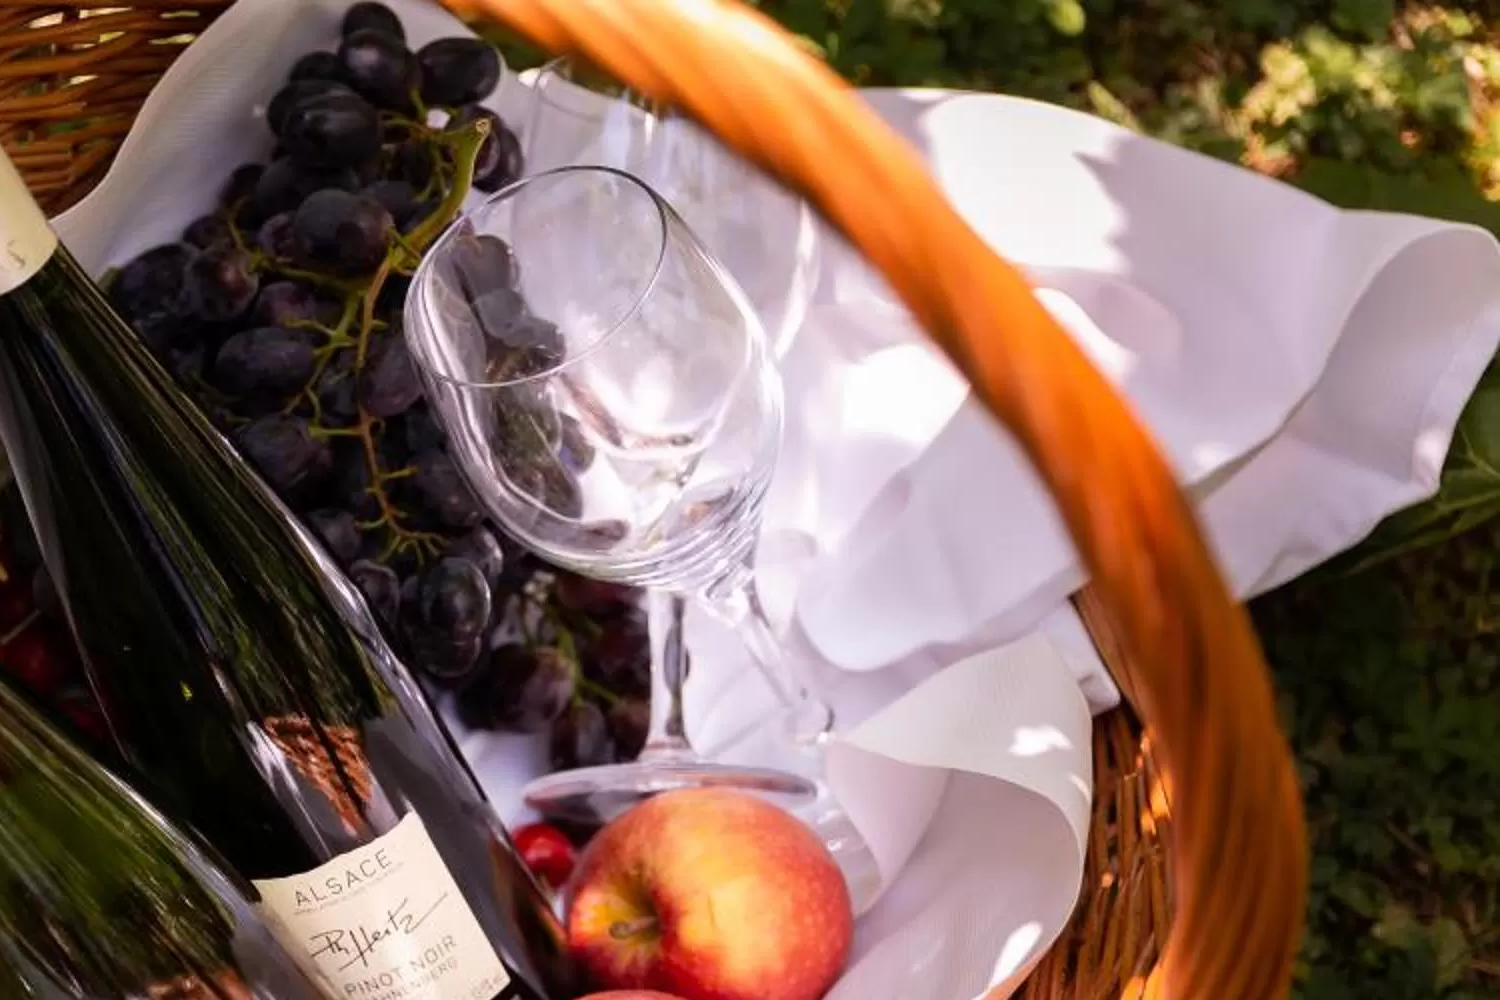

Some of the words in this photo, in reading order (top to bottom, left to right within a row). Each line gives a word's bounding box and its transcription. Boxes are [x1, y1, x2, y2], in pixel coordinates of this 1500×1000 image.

[294, 848, 392, 906] ALSACE
[344, 966, 402, 996] PINOT
[409, 935, 456, 969] NOIR
